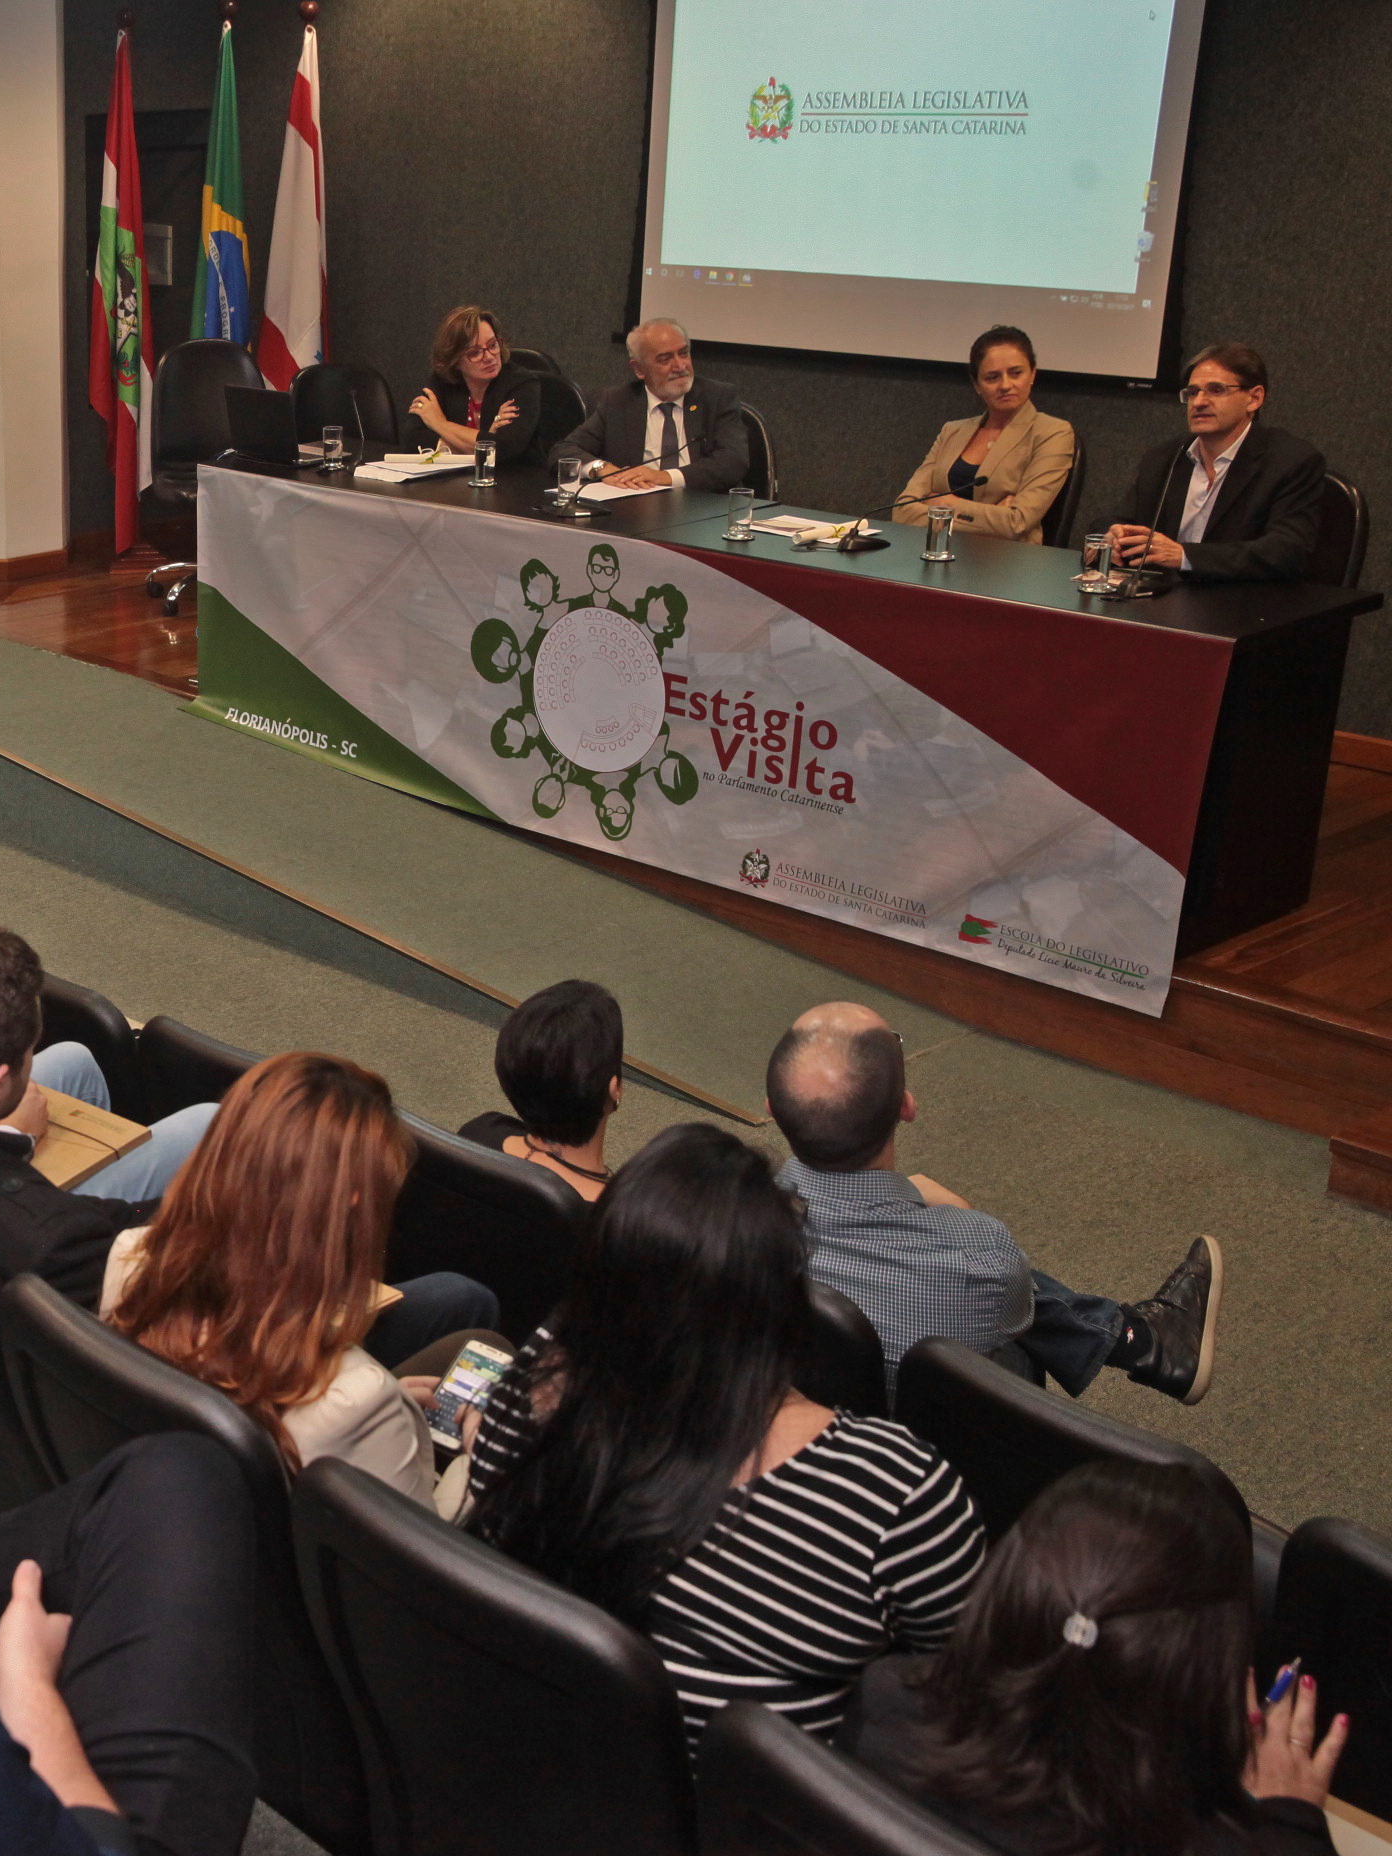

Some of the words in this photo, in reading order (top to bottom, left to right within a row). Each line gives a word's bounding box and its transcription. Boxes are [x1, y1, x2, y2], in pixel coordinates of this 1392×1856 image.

[802, 91, 906, 110] ASSEMBLEIA
[911, 90, 1029, 110] LEGISLATIVA
[799, 119, 821, 134] DO
[824, 119, 877, 135] ESTADO
[880, 120, 899, 135] DE
[902, 120, 949, 135] SANTA
[951, 120, 1027, 135] CATARINA
[224, 707, 328, 750] FLORIANÓPOLIS
[340, 740, 358, 758] SC
[663, 671, 838, 754] Estágio
[709, 726, 857, 805] Visita
[702, 770, 715, 782] no
[717, 774, 778, 798] Parlamento
[780, 789, 845, 815] Catarinense
[772, 877, 787, 888] DO
[789, 882, 826, 900] ESTADO
[827, 893, 840, 905] DE
[842, 897, 873, 915] SANTA
[875, 907, 927, 929] CATARINA
[775, 862, 846, 892] ASSEMBLEIA
[850, 882, 927, 915] LEGISLATIVA
[997, 938, 1036, 957] Deputado
[1063, 959, 1093, 975] Mauro
[1094, 966, 1108, 980] da
[1109, 971, 1146, 991] Silveira
[999, 924, 1043, 946] ESCOLA
[1046, 938, 1066, 952] DO
[1069, 944, 1150, 976] LEGISLATIVO
